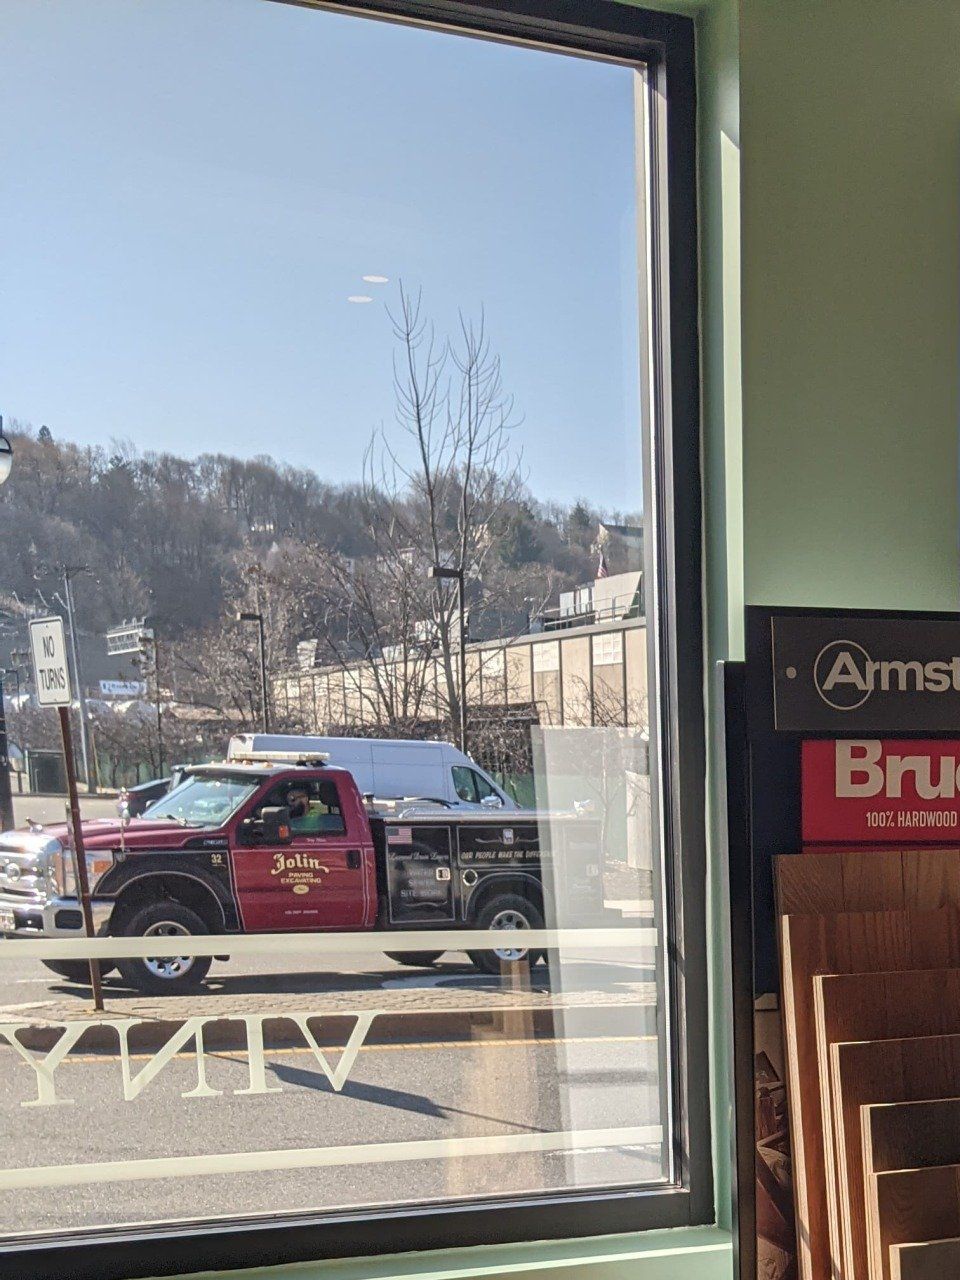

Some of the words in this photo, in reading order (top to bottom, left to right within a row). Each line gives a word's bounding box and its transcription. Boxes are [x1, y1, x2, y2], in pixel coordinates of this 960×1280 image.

[42, 635, 56, 659] NO
[39, 667, 66, 691] TURNS
[866, 811, 895, 827] 100%
[897, 811, 957, 827] HARDWOOD
[211, 854, 222, 864] 32
[271, 852, 329, 875] Jolin
